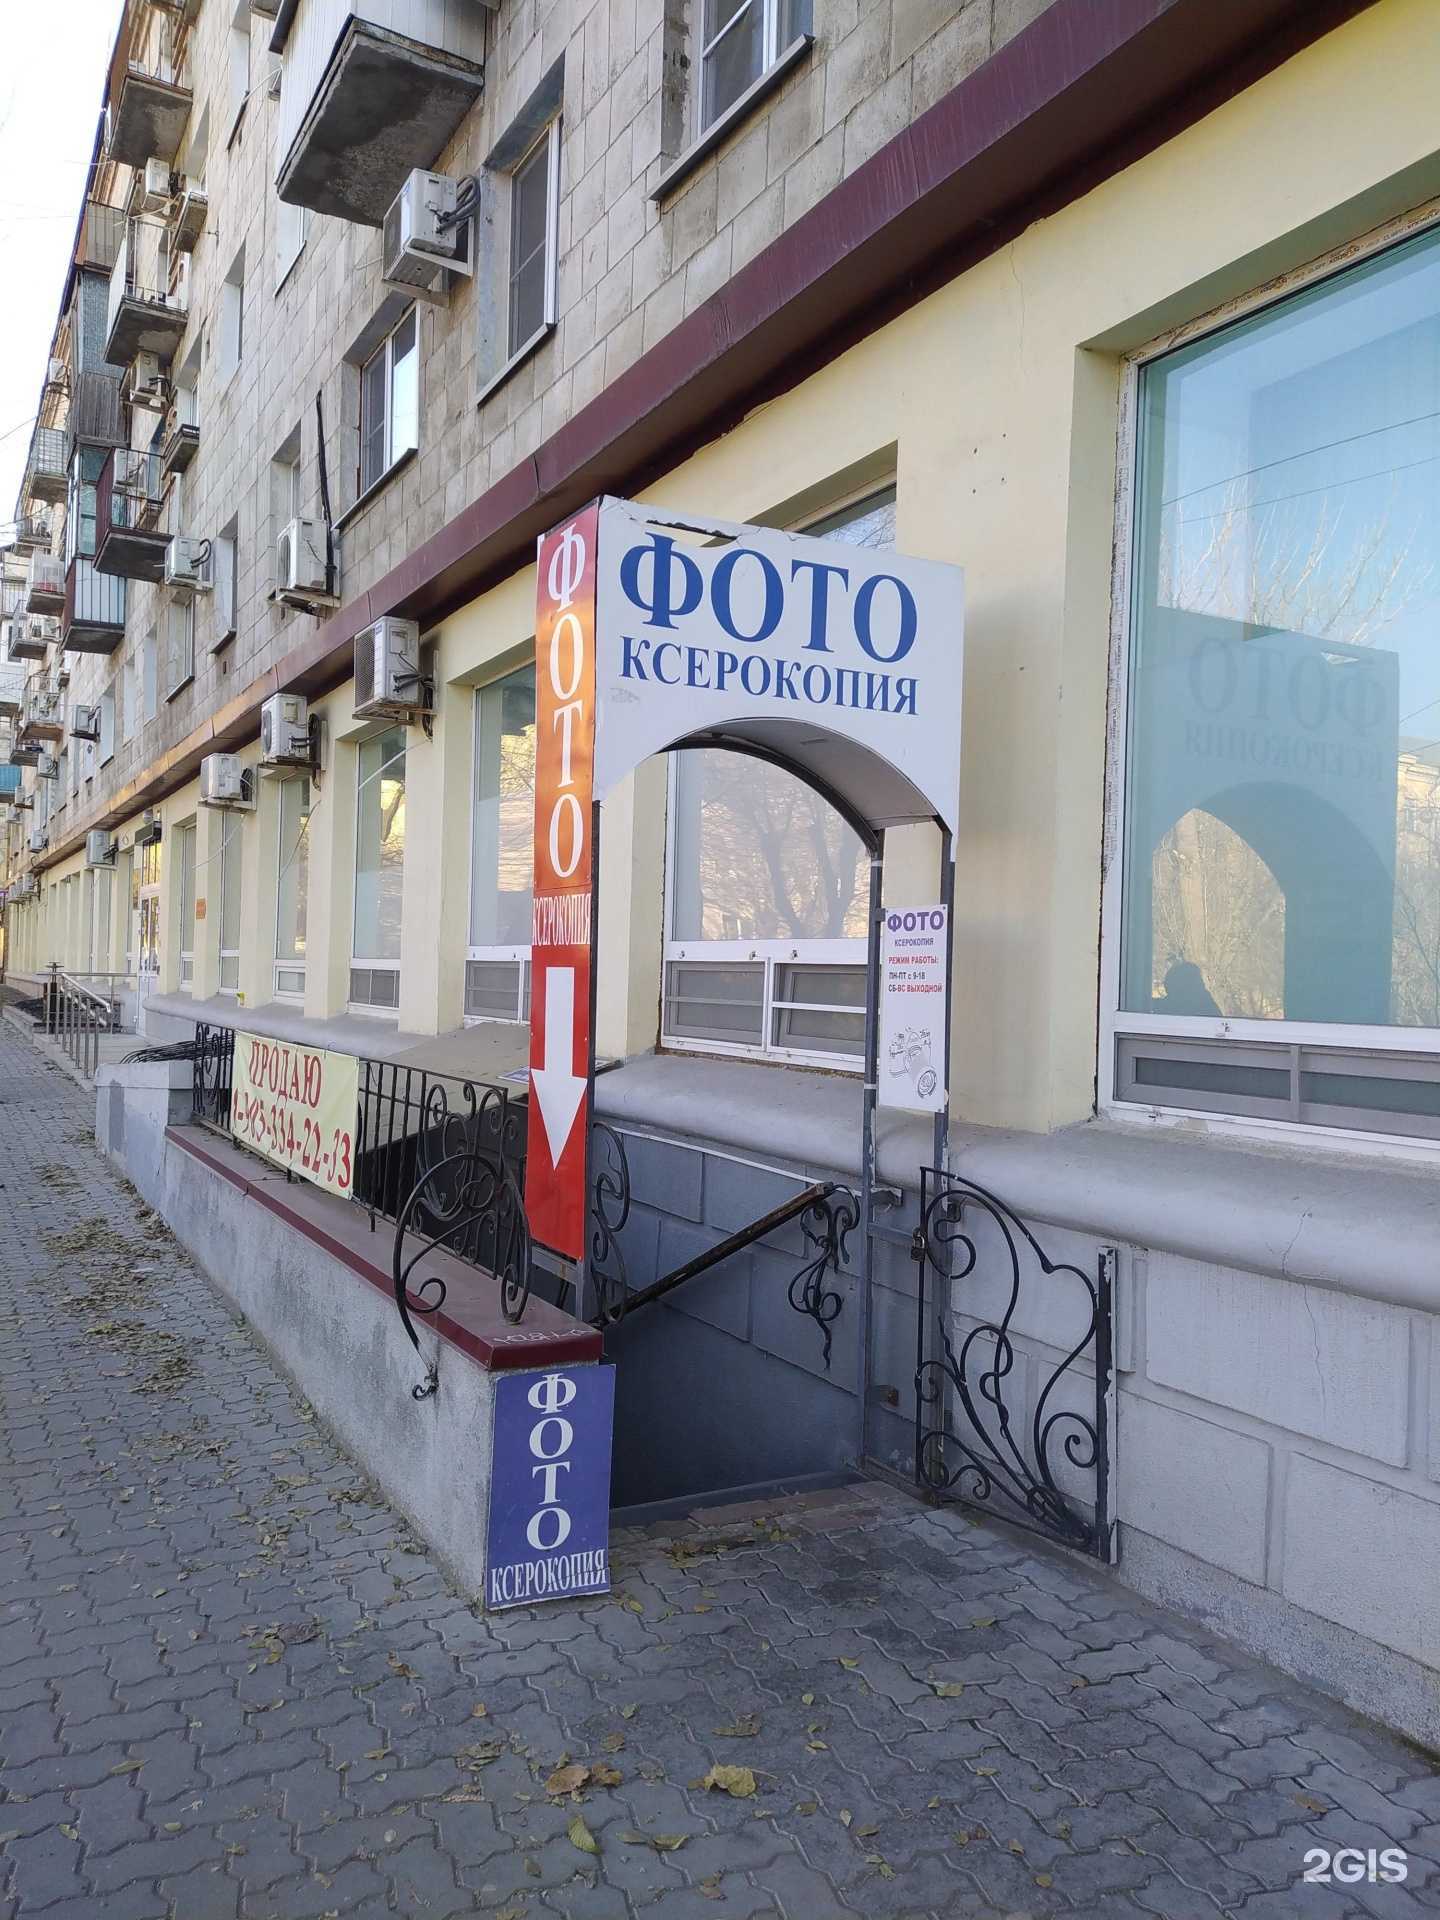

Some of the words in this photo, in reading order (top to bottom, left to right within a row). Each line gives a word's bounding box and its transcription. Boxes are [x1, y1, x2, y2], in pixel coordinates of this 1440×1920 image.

[619, 532, 918, 663] ФОТО
[547, 523, 586, 879] ФОТО
[618, 635, 919, 716] КСЕРОКОПИЯ
[532, 893, 591, 946] КСЕРОКОПИЯ
[887, 910, 944, 932] ФОТО
[895, 937, 934, 947] КСЕРОКОПИЯ
[888, 956, 910, 964] РЕЖИМ
[889, 971, 907, 980] ПН-ПТ
[907, 983, 943, 993] ВЫХОДНОЙ
[249, 1040, 322, 1109] ПРОДАЮ
[526, 1373, 577, 1550] ФОТО
[490, 1549, 607, 1604] КСЕРОКОПИЯ
